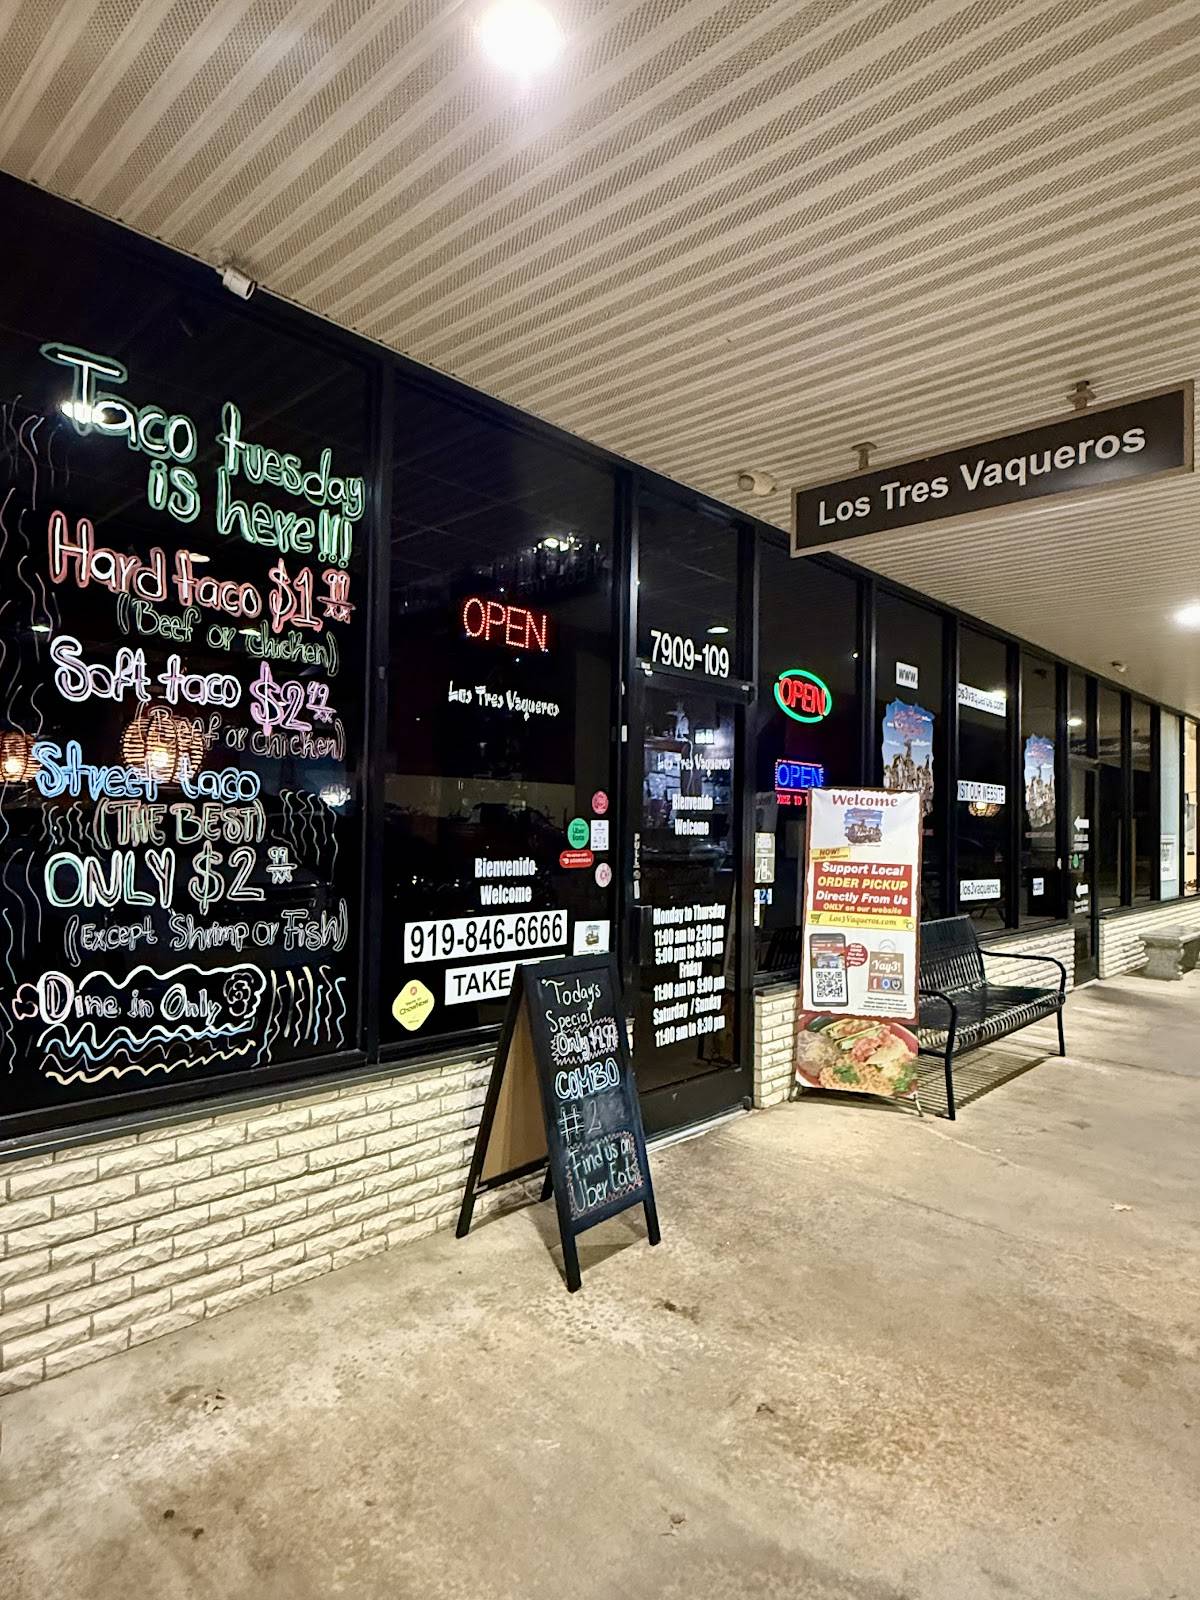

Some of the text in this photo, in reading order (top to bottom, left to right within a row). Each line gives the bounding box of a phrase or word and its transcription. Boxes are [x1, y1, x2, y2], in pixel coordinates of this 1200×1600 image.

[41, 342, 364, 520] Taco tuesday
[148, 460, 200, 522] is
[818, 427, 1146, 526] Los Tres Vaqueros
[48, 510, 166, 601] Hard
[172, 550, 261, 616] taco
[207, 625, 237, 650] or
[464, 598, 548, 652] OPEN
[650, 630, 729, 678] 7909-109
[51, 635, 152, 702] Soft
[158, 654, 241, 708] taco
[448, 680, 560, 721] Los Tres Vaqueros
[780, 678, 826, 715] OPEN
[226, 726, 249, 751] or
[32, 740, 260, 803] Street taco
[777, 764, 822, 787] OPEN
[672, 794, 713, 811] Bienvenido
[833, 794, 898, 808] Welcome
[93, 797, 265, 849] (THE BEST)
[675, 819, 709, 836] Welcome
[44, 848, 175, 909] ONLY
[475, 857, 537, 878] Bienvenido
[822, 862, 904, 876] Support Local
[480, 884, 532, 905] Welcome
[816, 890, 908, 905] Directly From Us
[817, 876, 908, 891] ORDER PICKUP
[653, 903, 726, 925] Monday to Thursday
[823, 903, 844, 911] ONLY
[872, 905, 902, 914] website
[169, 912, 250, 952] Shrimp
[252, 920, 279, 946] or
[281, 898, 349, 953] Fish)
[410, 913, 563, 958] 919-846-6666
[654, 928, 674, 947] 11:00
[687, 927, 695, 942] to
[687, 944, 695, 959] to
[453, 968, 512, 997] TAKE
[679, 961, 702, 978] Friday
[39, 970, 222, 1025] Dine in Only
[542, 979, 601, 1006] Today's
[654, 982, 674, 1002] 11:00
[687, 980, 695, 995] to
[546, 1003, 592, 1033] Special
[653, 1002, 689, 1025] Saturday
[556, 1031, 590, 1060] Only
[655, 1026, 675, 1047] 11:00
[688, 1022, 697, 1037] to
[555, 1058, 620, 1100] COMBO
[569, 1143, 604, 1180] Find
[604, 1142, 619, 1158] us
[571, 1158, 640, 1213] Uber Eats
